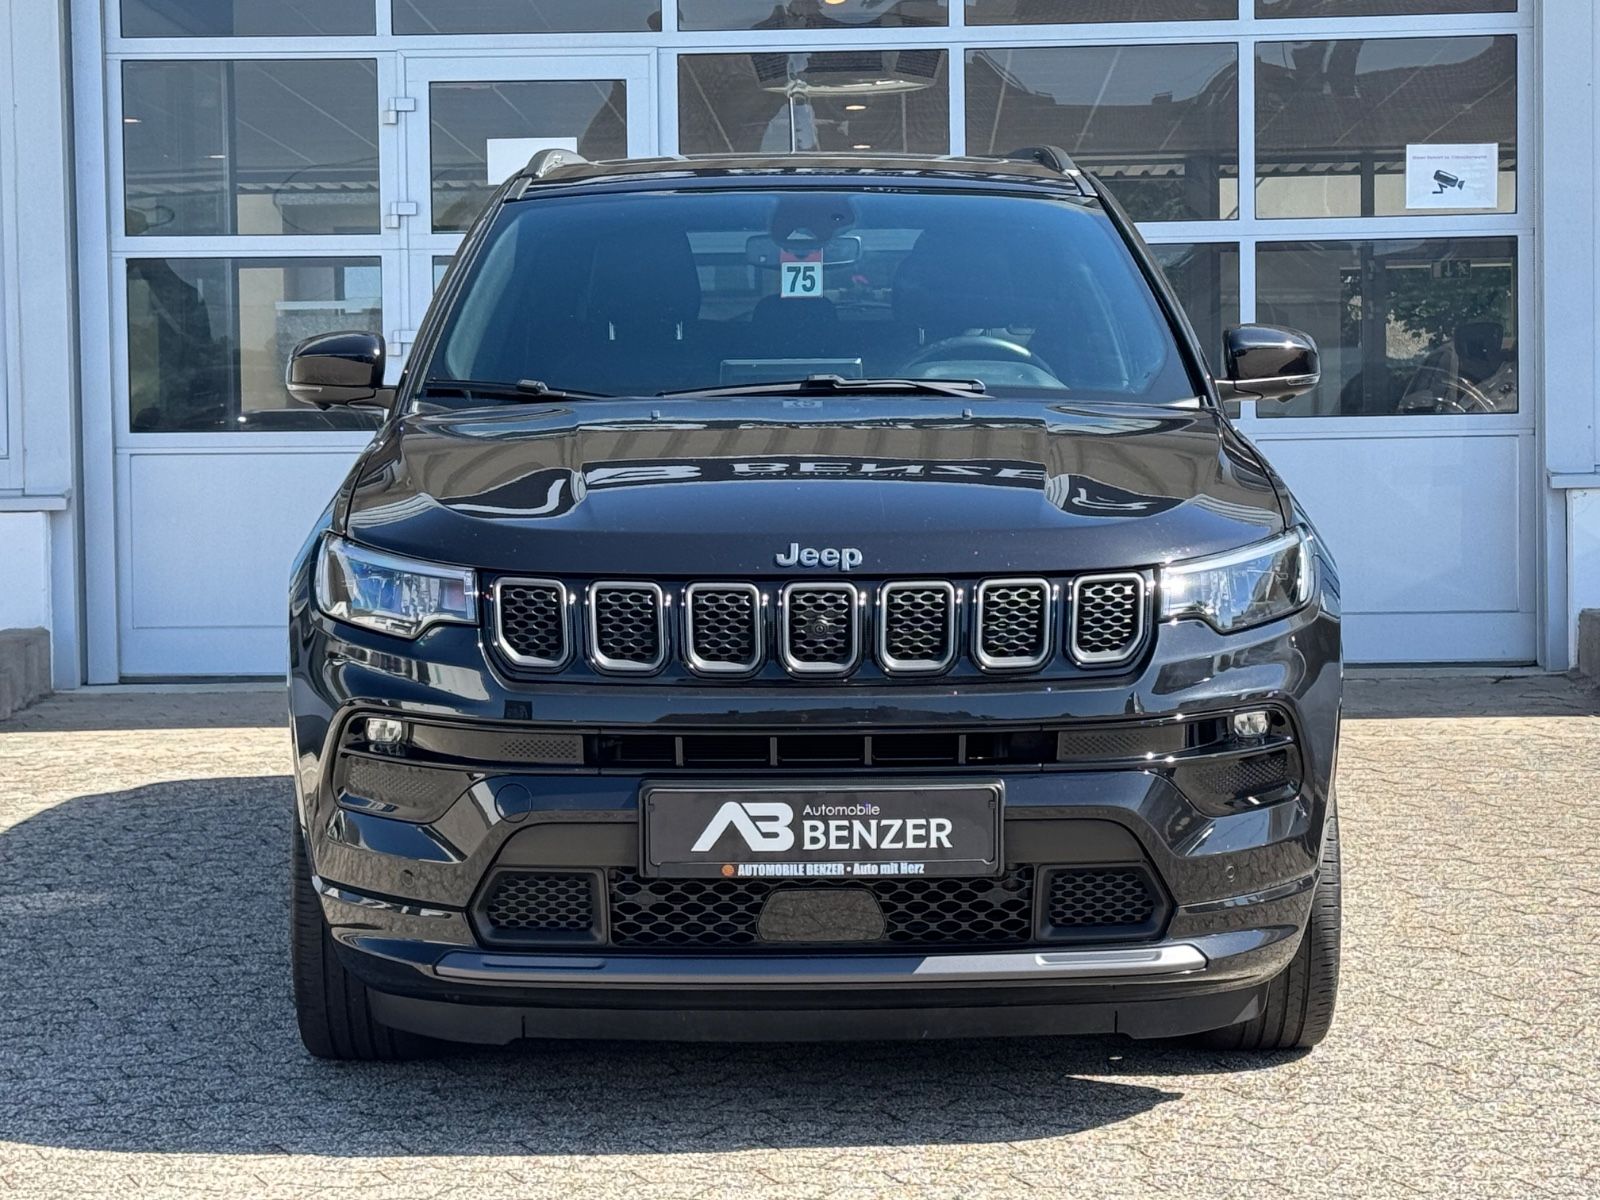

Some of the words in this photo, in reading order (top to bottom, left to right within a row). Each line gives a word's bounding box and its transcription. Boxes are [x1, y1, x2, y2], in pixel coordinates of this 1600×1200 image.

[786, 266, 816, 293] 75
[776, 542, 863, 571] Jeep
[803, 803, 880, 816] Automobile
[802, 818, 953, 850] BENZER
[737, 863, 805, 877] AUTOMOBILE
[806, 863, 844, 876] BENZER
[853, 863, 878, 875] Auto
[880, 863, 899, 875] mit
[900, 863, 925, 875] Herz
